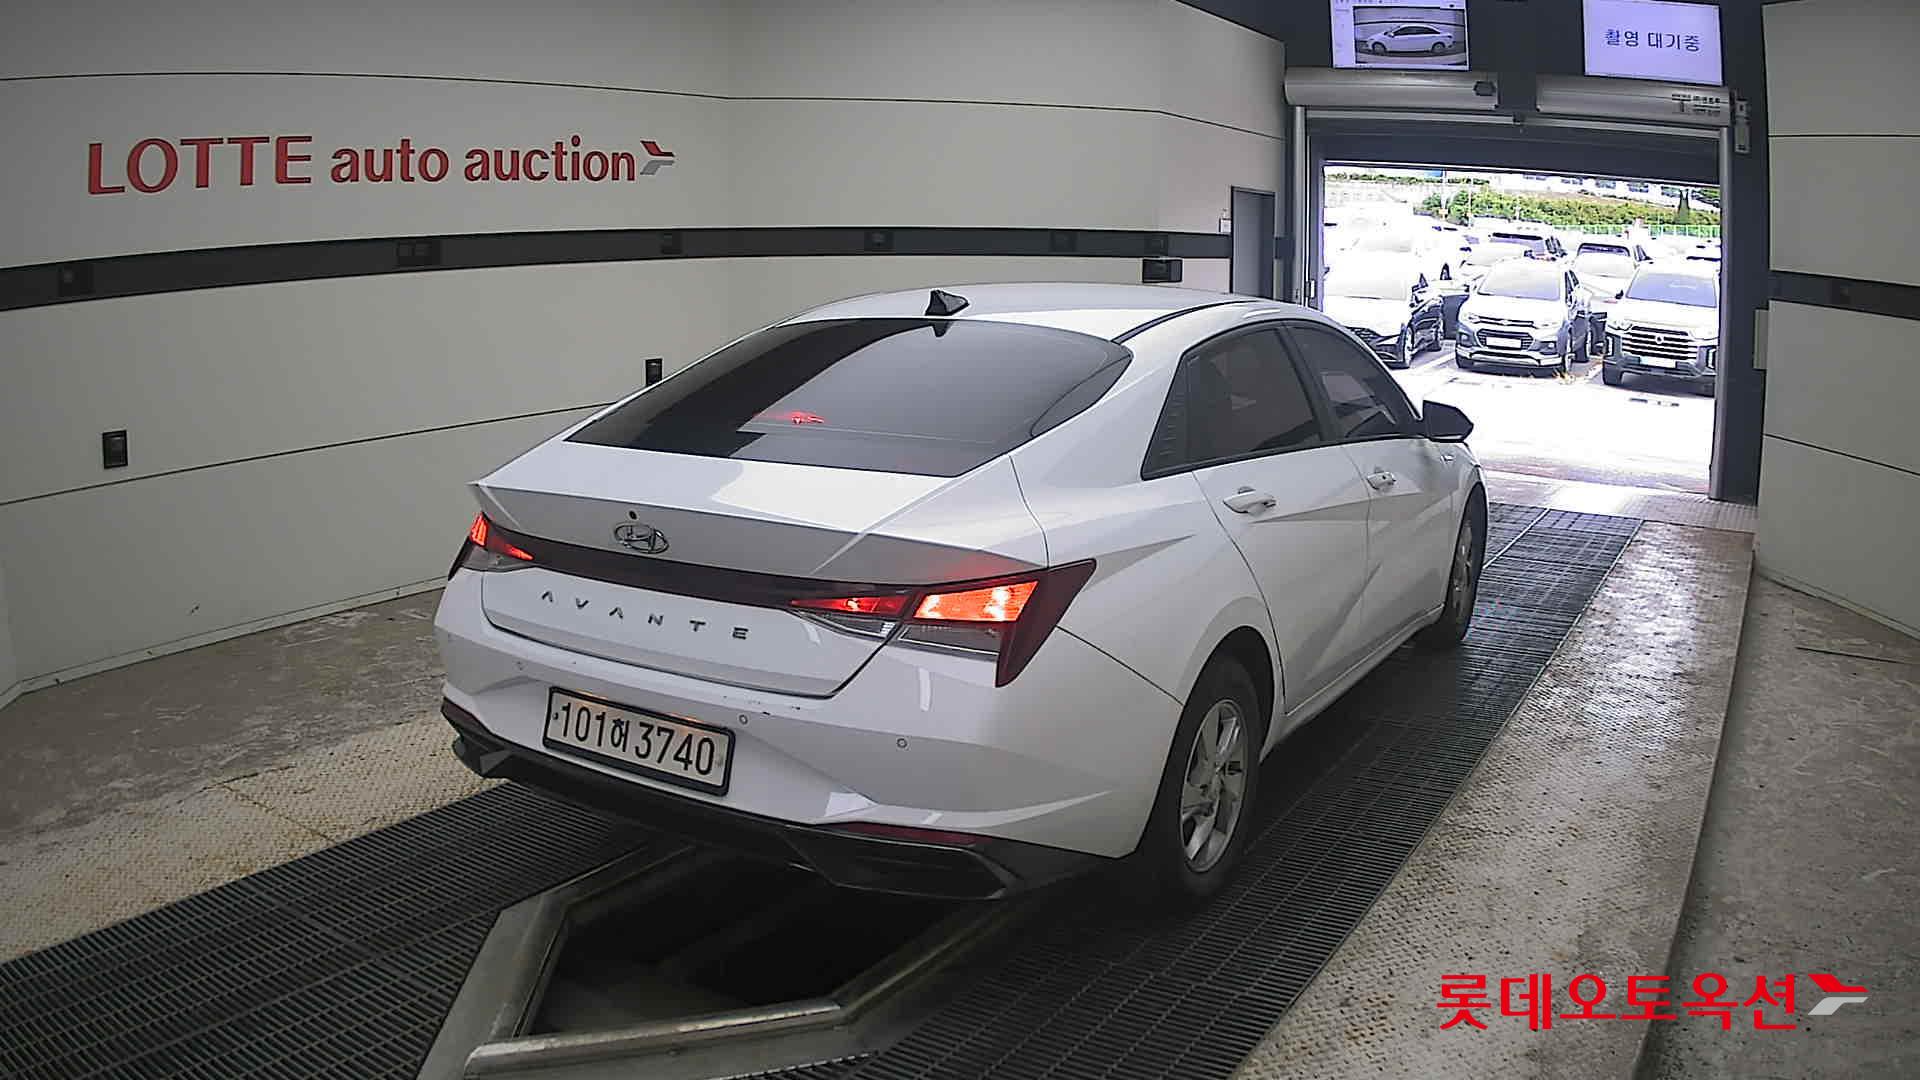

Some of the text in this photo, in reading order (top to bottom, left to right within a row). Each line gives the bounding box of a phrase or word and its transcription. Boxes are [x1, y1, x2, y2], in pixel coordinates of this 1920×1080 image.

[1605, 28, 1700, 52] 촬영 대기중
[88, 135, 635, 195] LOTTE auto auction
[541, 591, 749, 640] AVANTE
[561, 702, 715, 776] 101허3740
